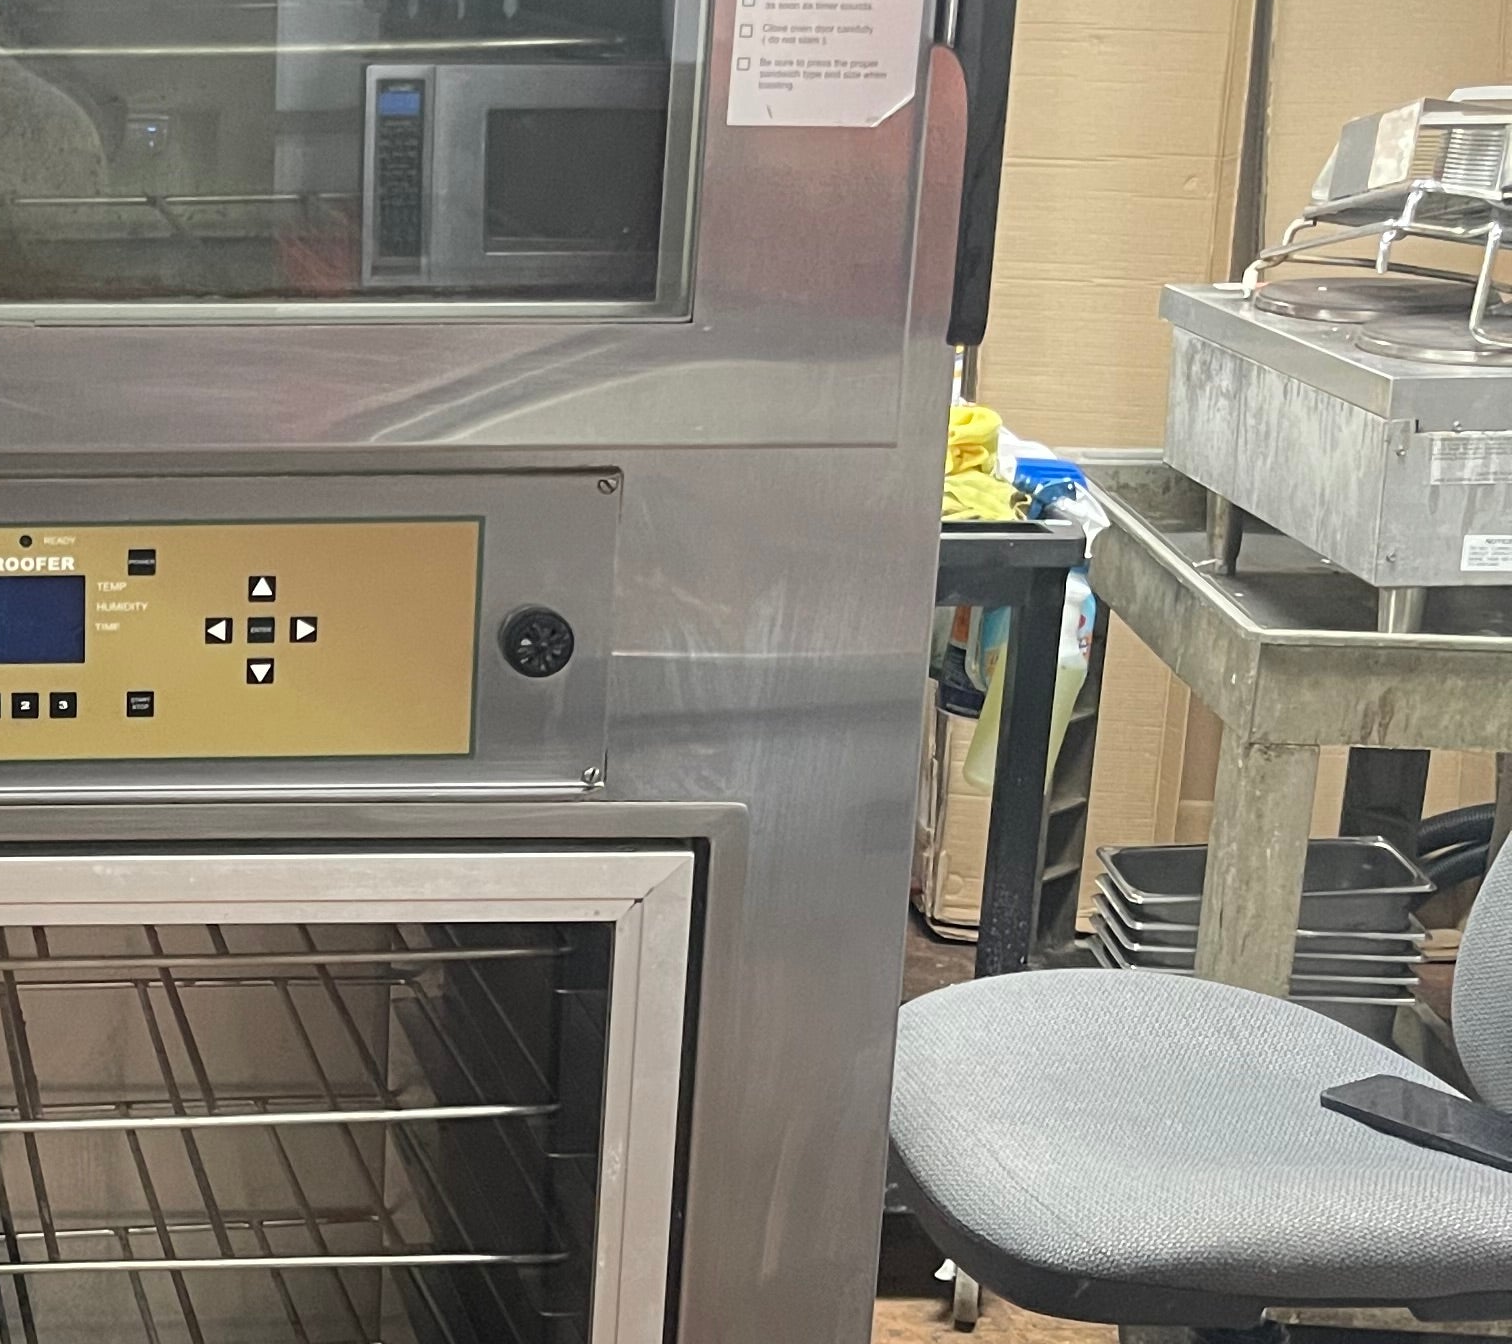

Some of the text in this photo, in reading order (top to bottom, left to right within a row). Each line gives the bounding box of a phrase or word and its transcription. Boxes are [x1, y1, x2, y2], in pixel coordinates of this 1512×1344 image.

[42, 536, 76, 546] READY
[96, 581, 127, 592] TEMP
[96, 601, 149, 612] HUMIDITY
[95, 622, 120, 631] TIME
[20, 699, 31, 711] 2
[58, 699, 69, 711] 3
